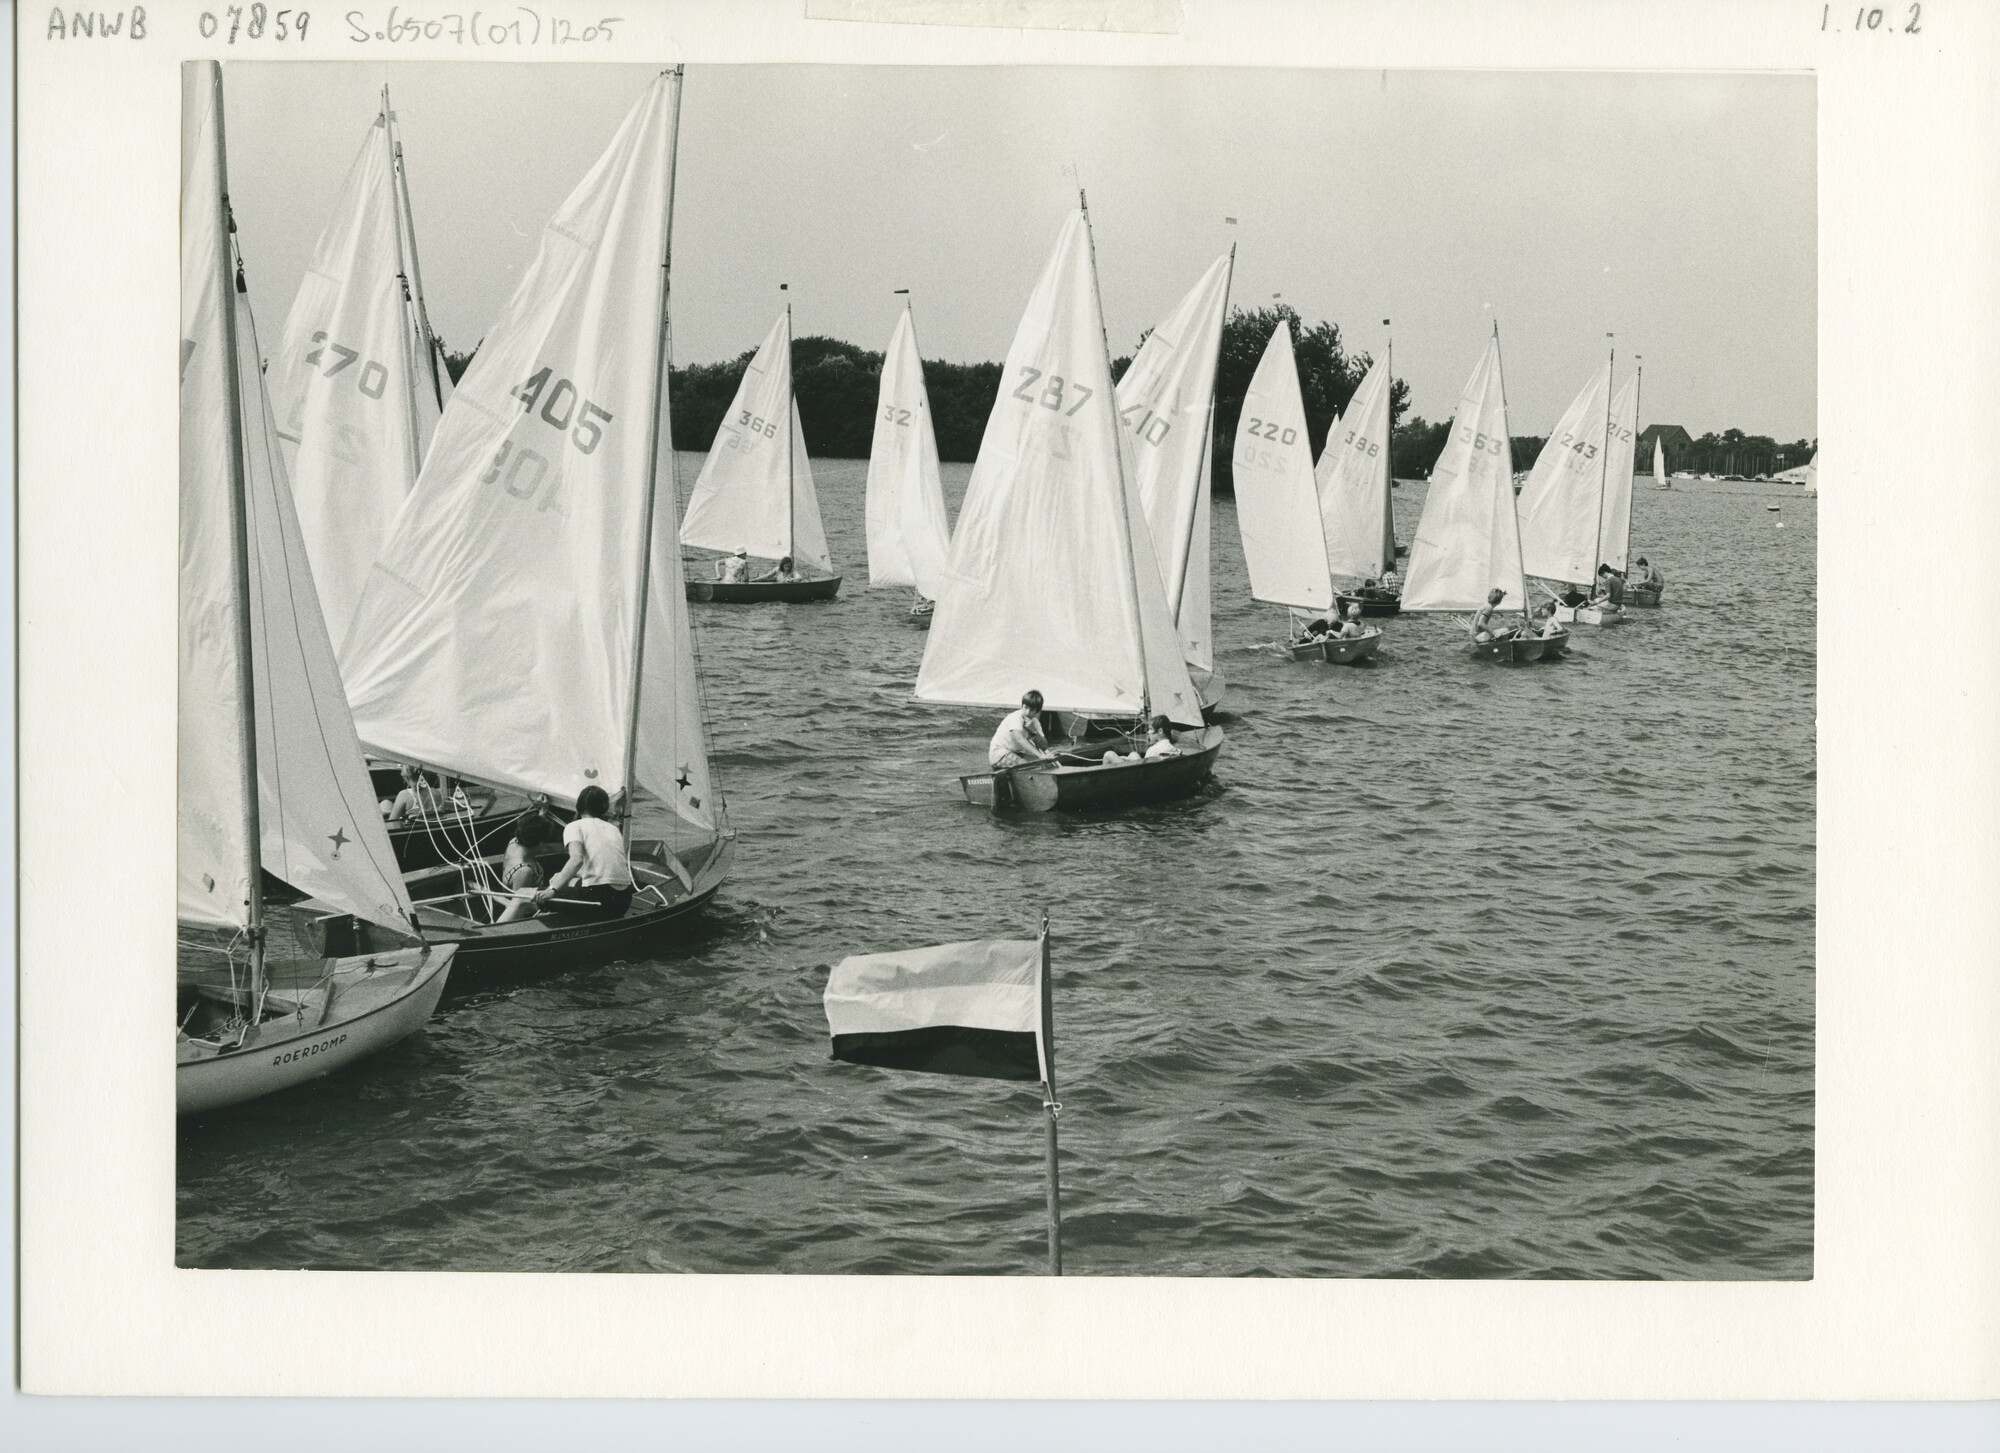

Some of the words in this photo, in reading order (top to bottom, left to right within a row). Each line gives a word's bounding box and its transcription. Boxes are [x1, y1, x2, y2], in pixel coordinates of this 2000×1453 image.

[47, 6, 147, 41] ANWB
[199, 2, 310, 45] 07859
[305, 331, 389, 400] 270
[1012, 365, 1093, 417] 287
[510, 366, 613, 455] 405
[739, 410, 777, 439] 366
[1247, 417, 1297, 446] 220
[1345, 430, 1380, 458] 388
[1459, 426, 1503, 457] 363
[1560, 433, 1598, 460] 243
[273, 1034, 347, 1067] ROERDOMP
